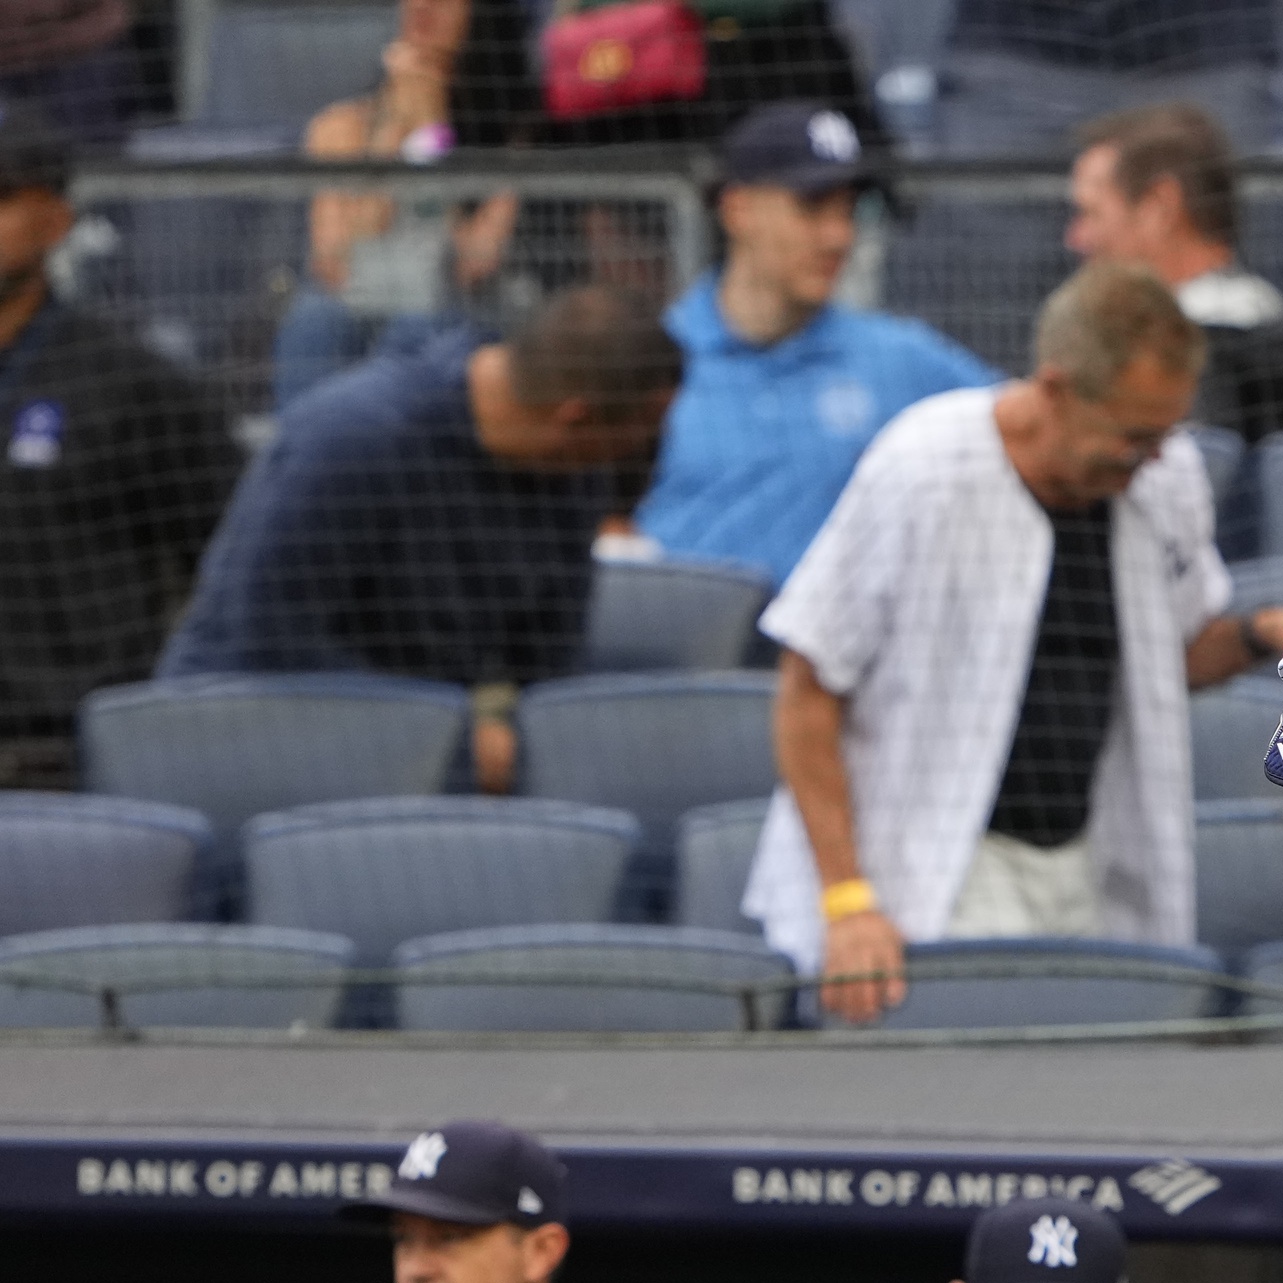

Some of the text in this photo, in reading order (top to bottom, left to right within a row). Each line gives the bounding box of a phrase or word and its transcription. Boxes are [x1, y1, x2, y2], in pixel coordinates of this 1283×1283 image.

[77, 1157, 198, 1197] BANK
[204, 1159, 265, 1198] OF
[732, 1167, 854, 1206] BANK
[860, 1169, 921, 1206] OF
[1027, 1214, 1079, 1267] NY
